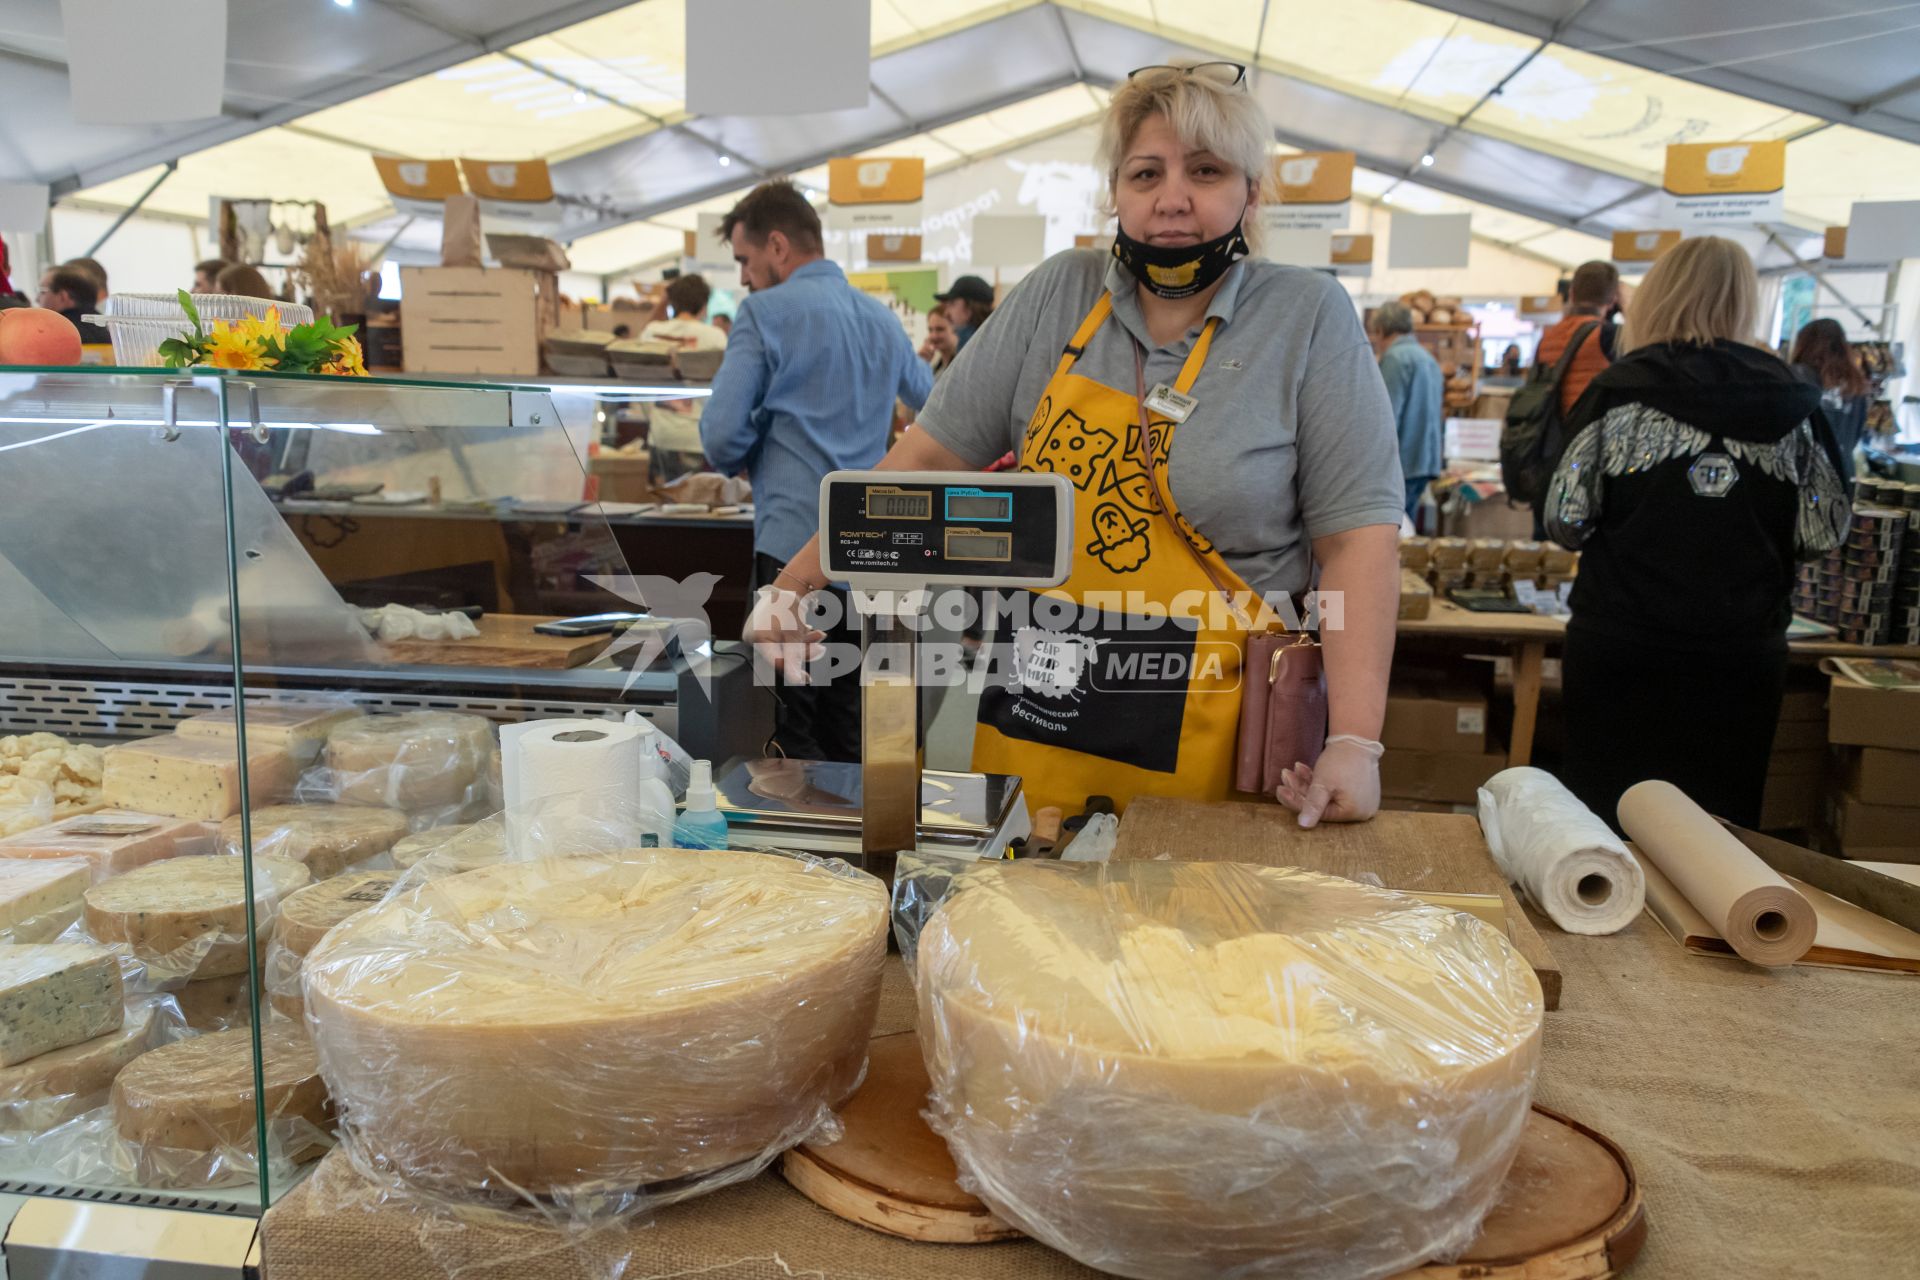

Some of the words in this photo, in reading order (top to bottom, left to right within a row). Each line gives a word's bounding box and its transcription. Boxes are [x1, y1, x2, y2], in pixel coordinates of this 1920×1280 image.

[1033, 640, 1061, 656] СЫР
[1028, 653, 1061, 671] ПИР
[1027, 668, 1055, 684] МИР
[1011, 701, 1069, 732] фестиваль
